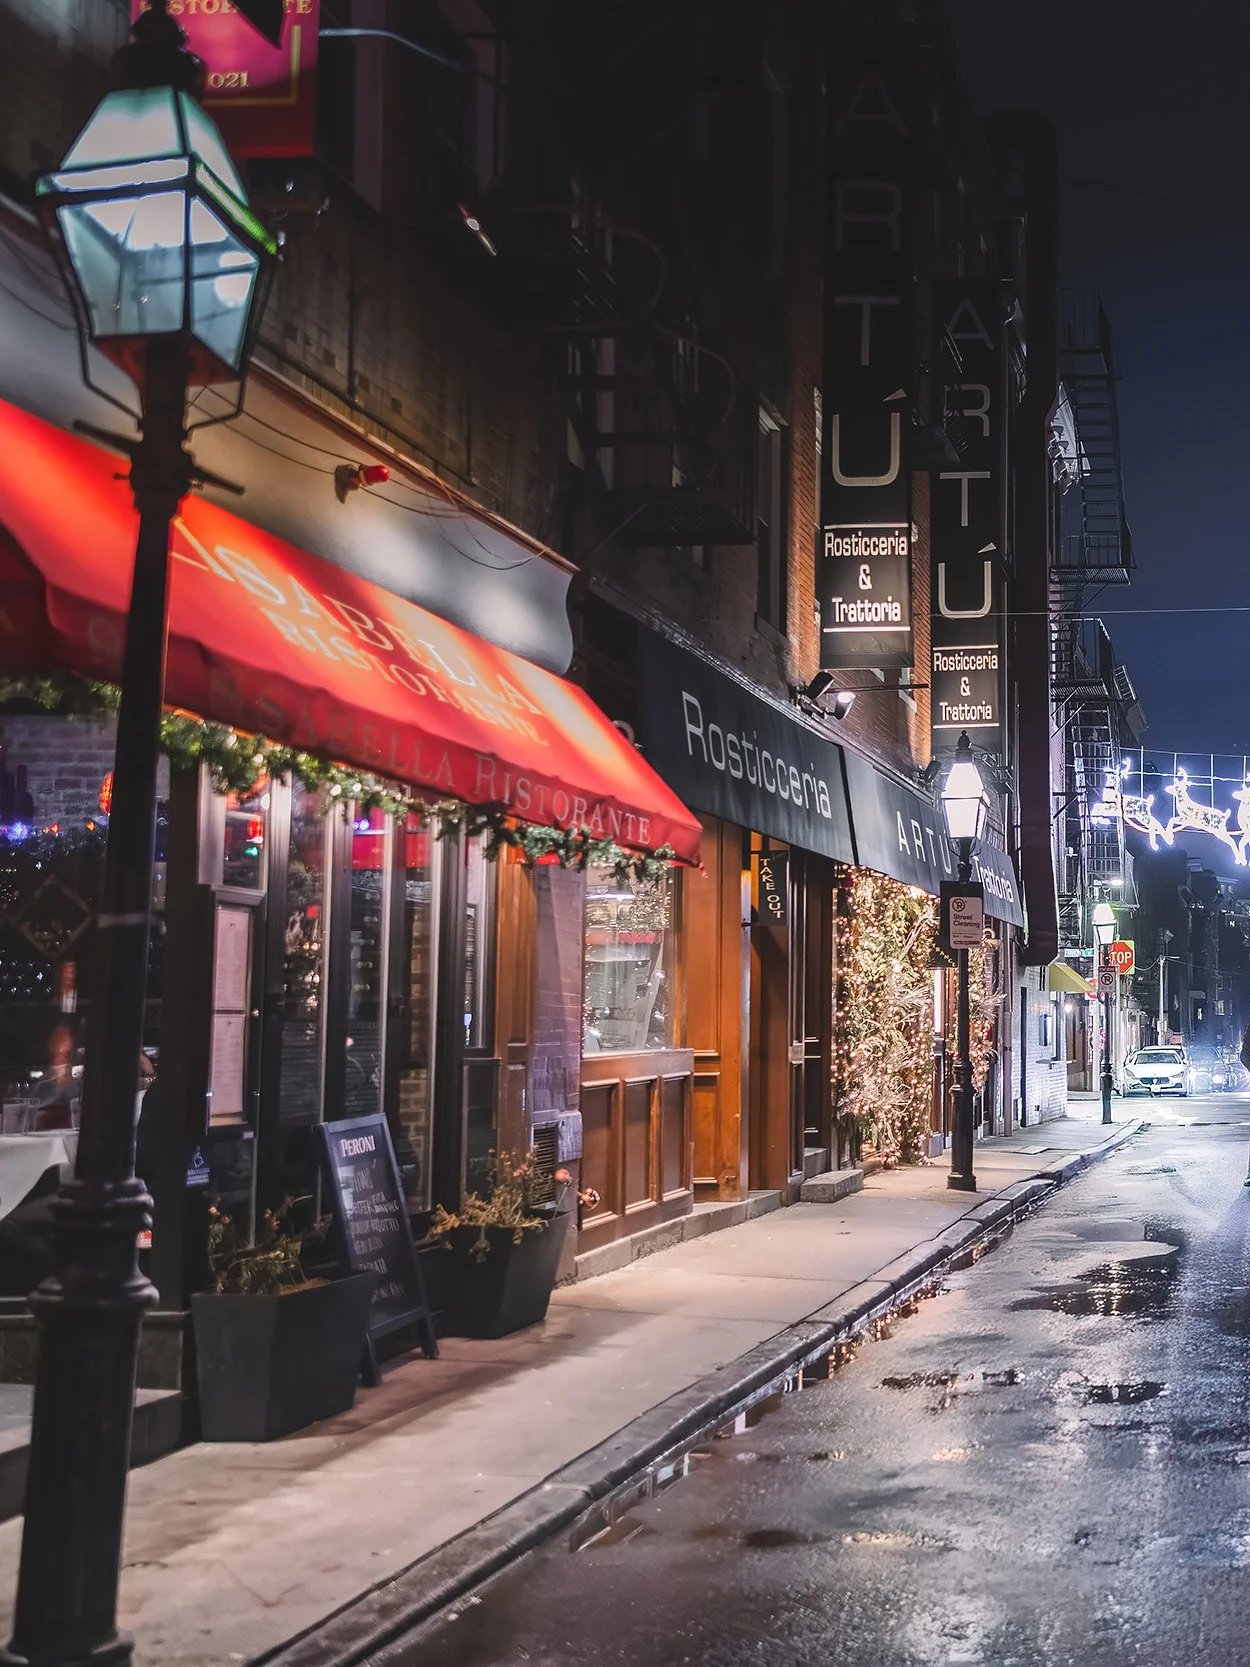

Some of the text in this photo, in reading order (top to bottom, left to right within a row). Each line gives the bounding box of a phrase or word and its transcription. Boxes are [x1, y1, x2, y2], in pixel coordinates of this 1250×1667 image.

[207, 71, 250, 88] 021
[825, 530, 907, 557] Rosticceria
[858, 564, 872, 590] &
[832, 596, 901, 622] Trattoria
[933, 650, 998, 672] Rosticceria
[960, 676, 971, 697] &
[939, 700, 992, 722] Trattoria
[682, 690, 832, 820] Rosticceria
[475, 751, 652, 847] RISTORANTE
[759, 857, 776, 891] TAKE
[972, 855, 1014, 903] Trattoria
[767, 894, 785, 919] OUT
[953, 913, 973, 921] Street
[953, 920, 981, 929] Cleaning
[1111, 951, 1132, 965] TOP
[340, 1135, 376, 1157] PERONI
